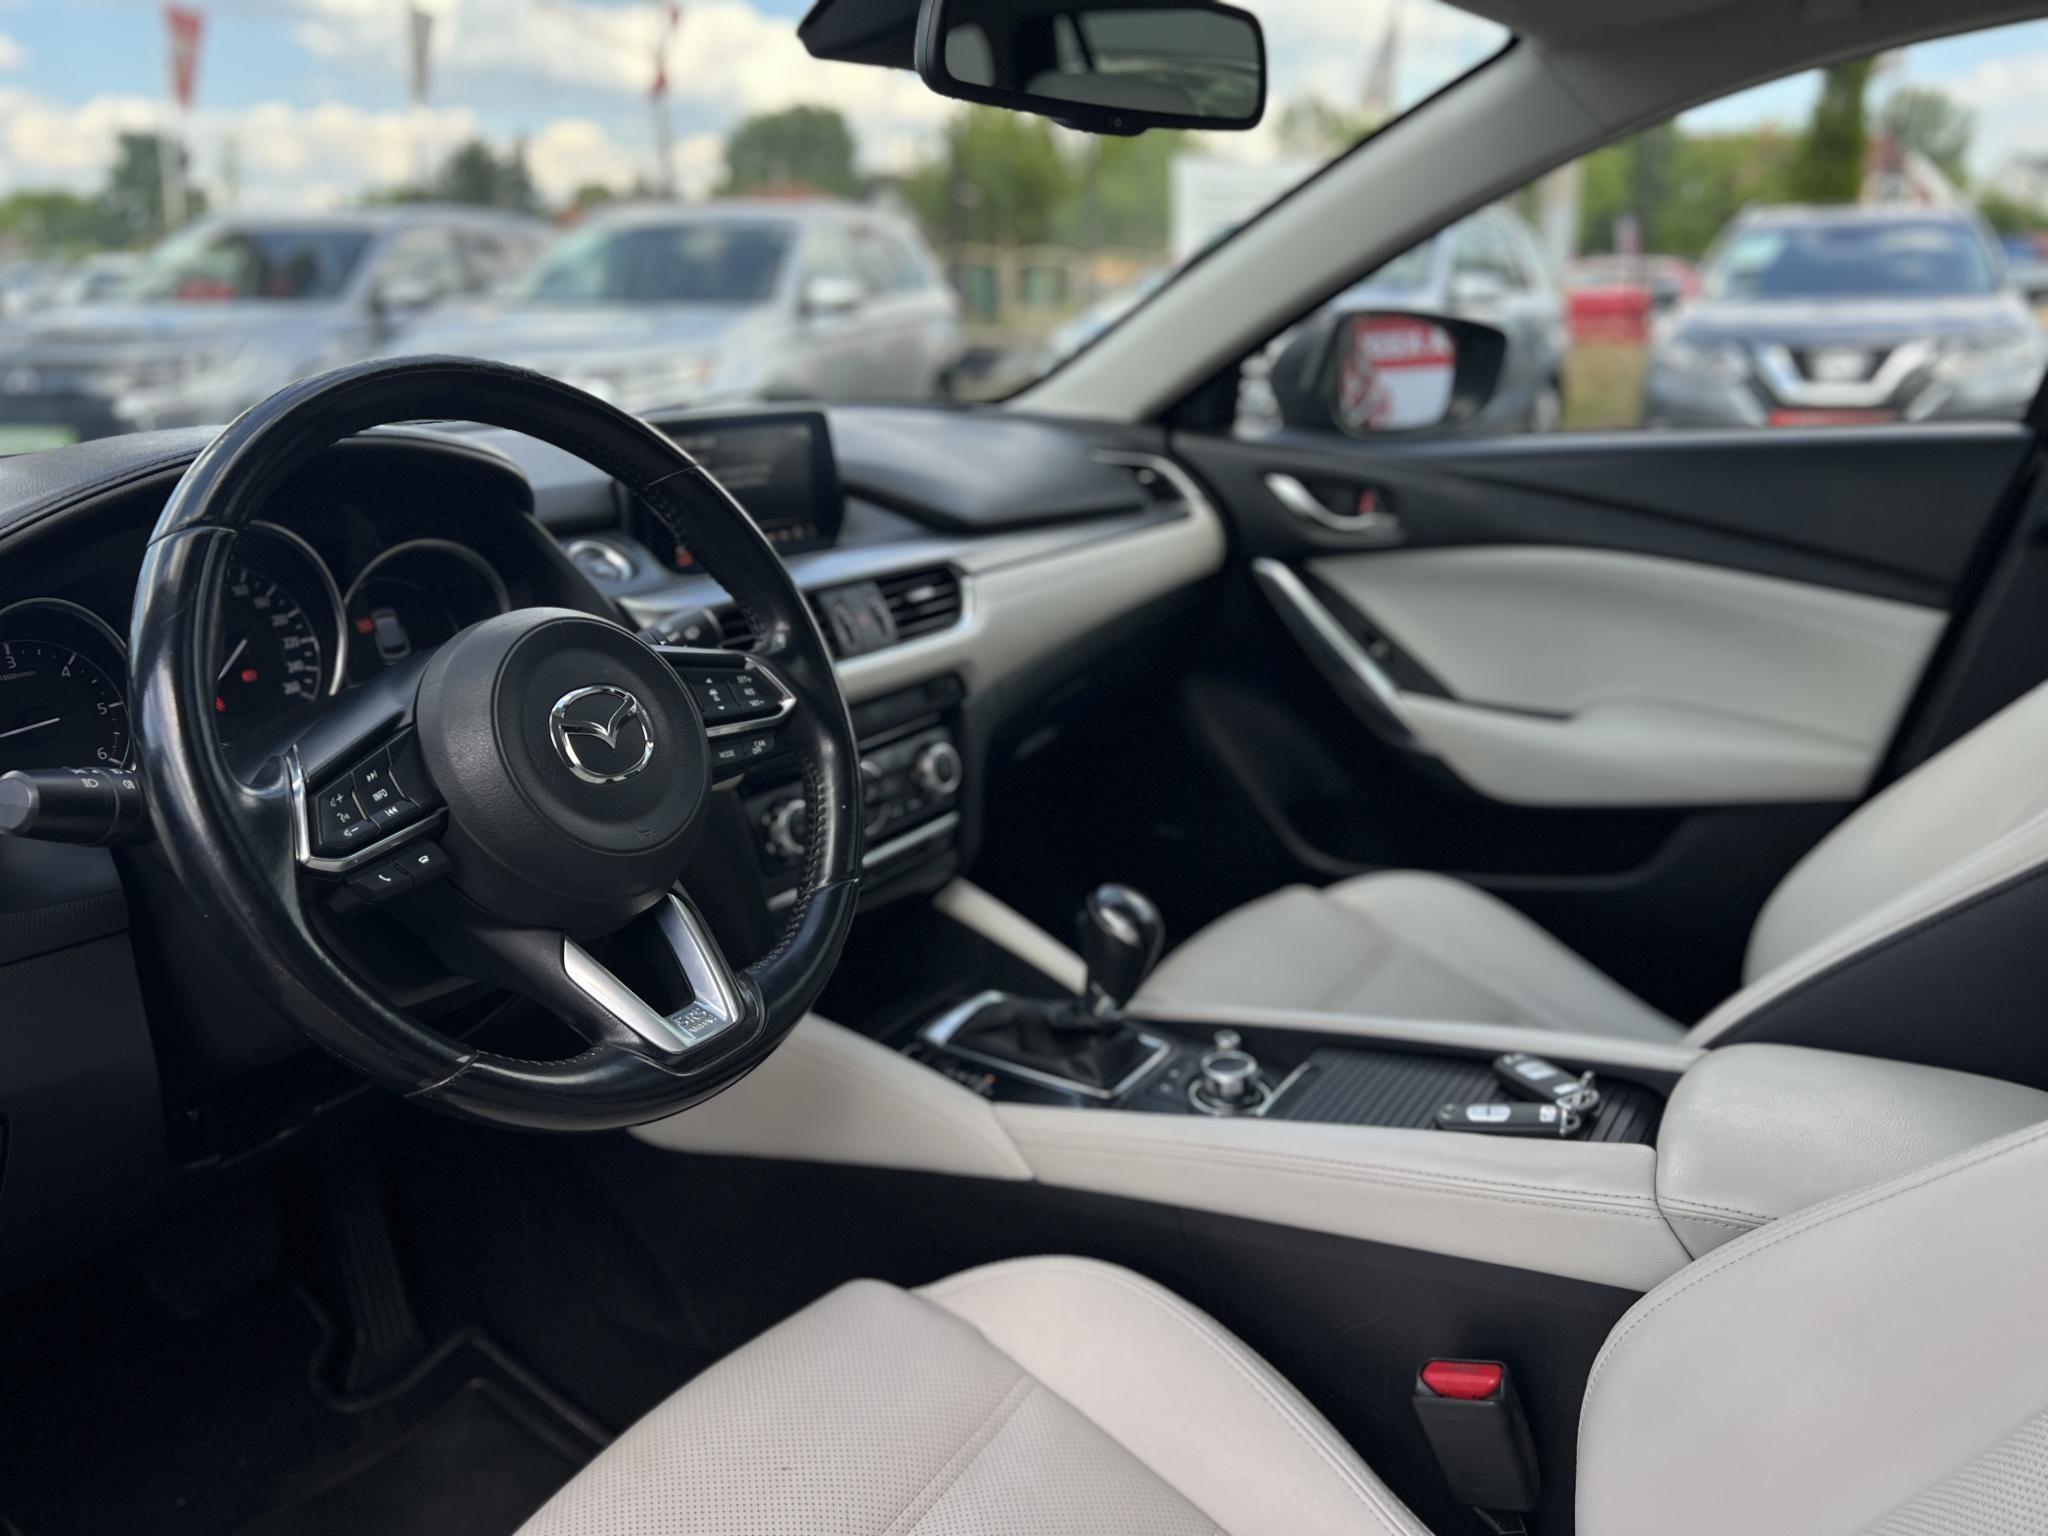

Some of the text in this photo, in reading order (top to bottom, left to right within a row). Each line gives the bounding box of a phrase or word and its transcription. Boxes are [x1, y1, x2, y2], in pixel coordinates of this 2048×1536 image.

[5, 656, 17, 669] 3
[61, 665, 71, 677] 4
[97, 702, 108, 715] 5
[97, 747, 108, 760] 6
[372, 788, 388, 801] INFO
[674, 1007, 707, 1026] SRS
